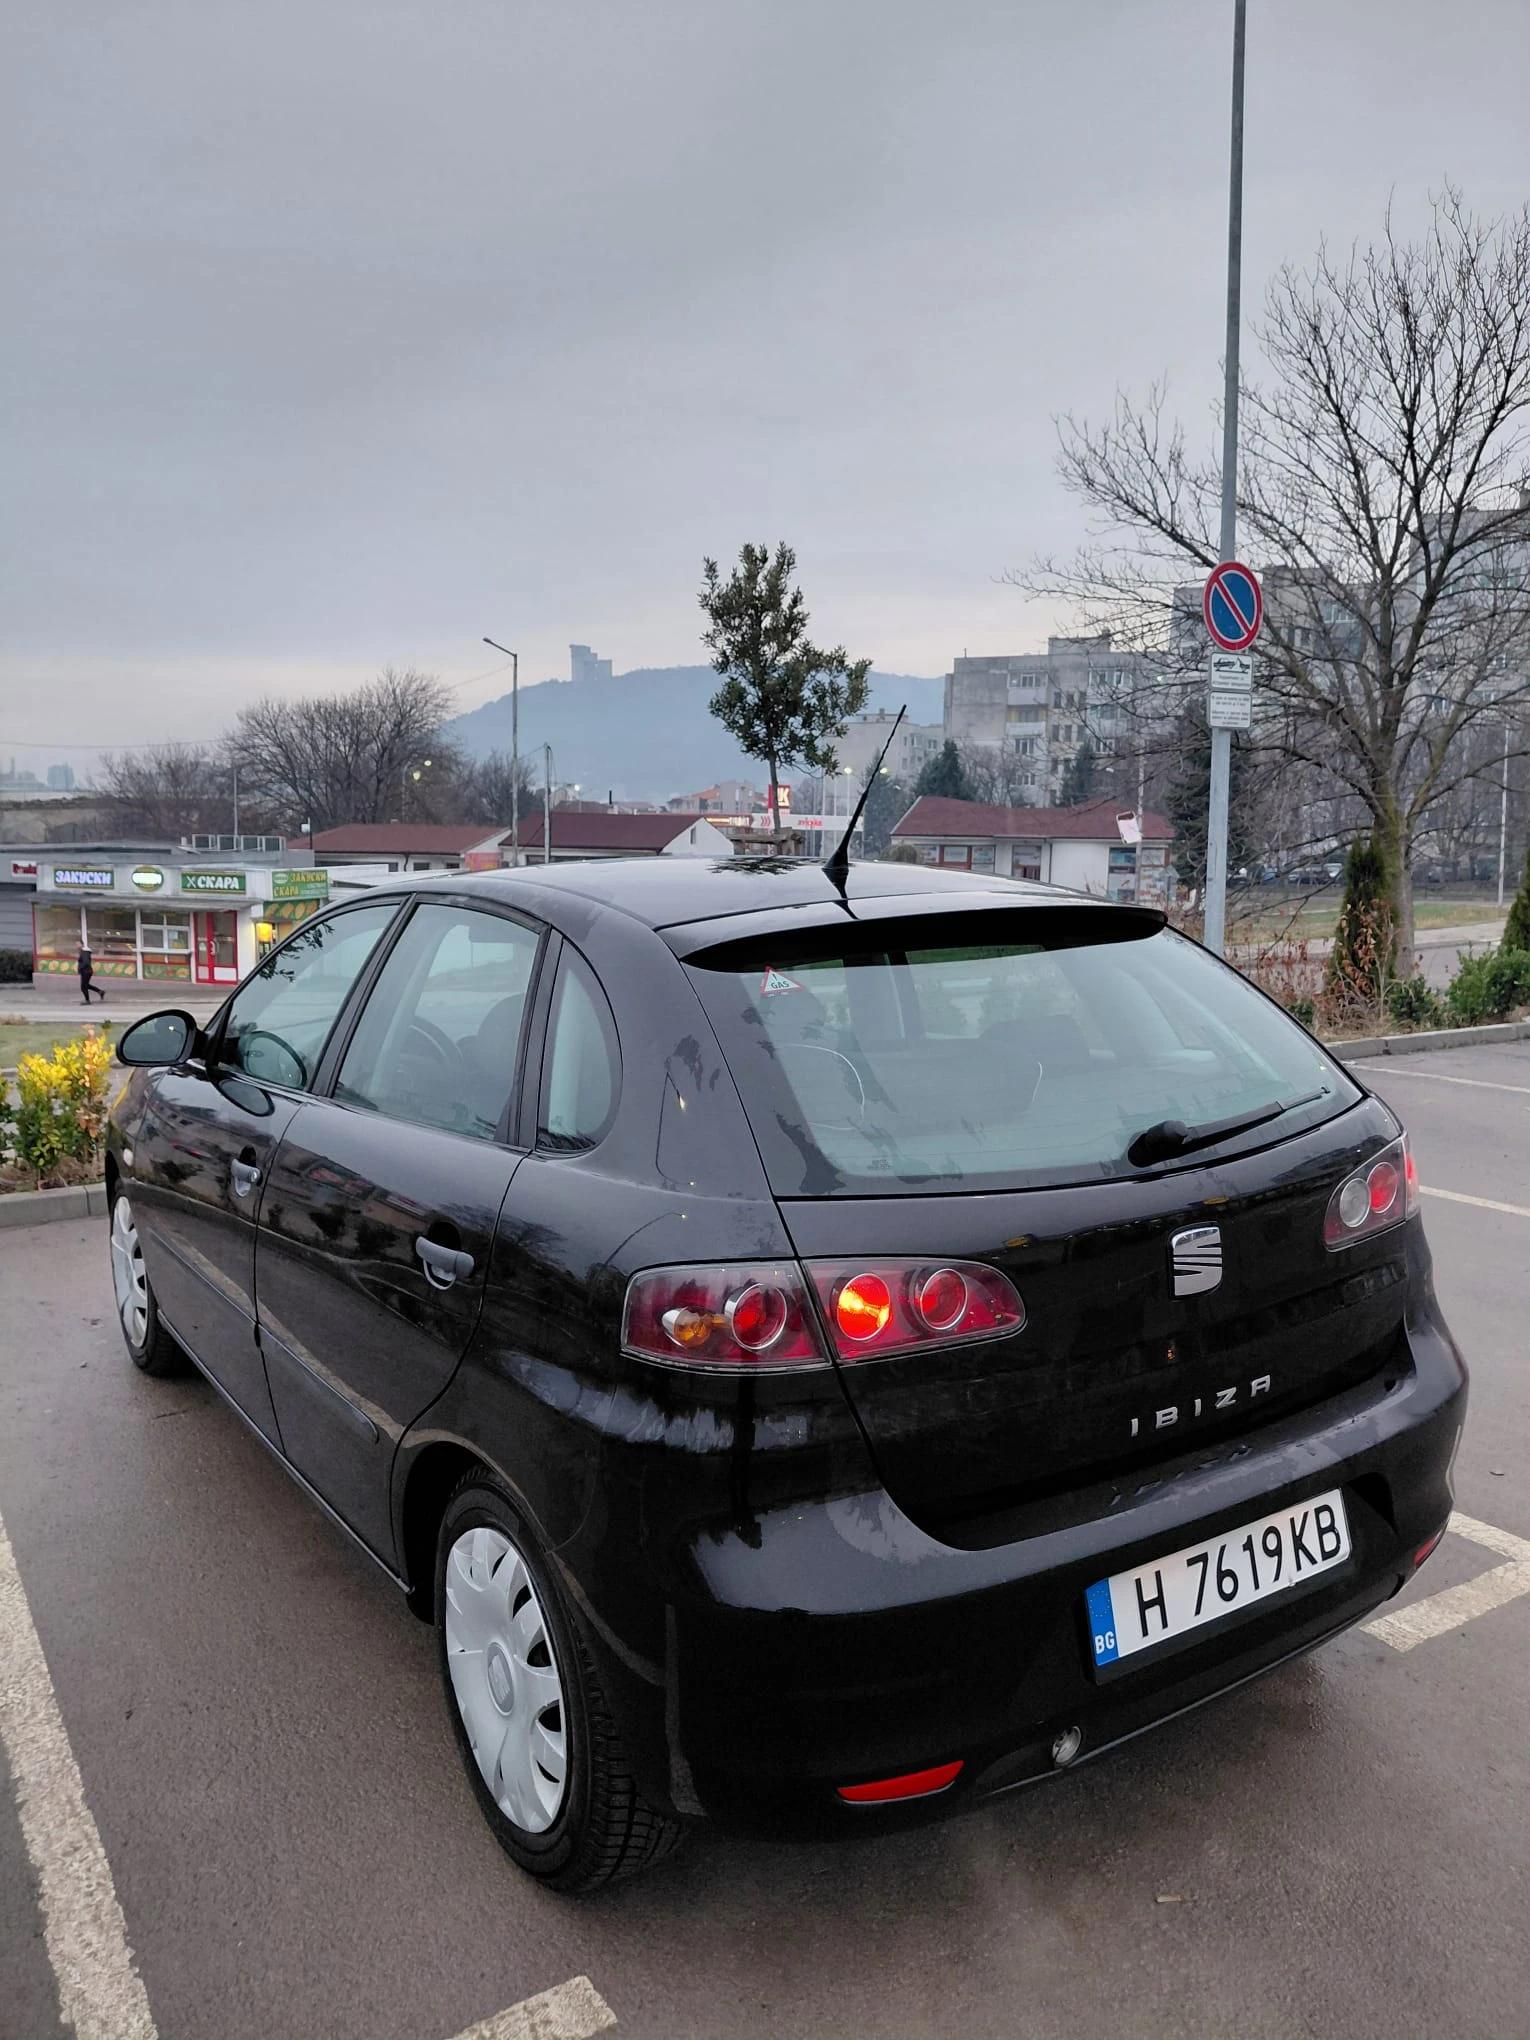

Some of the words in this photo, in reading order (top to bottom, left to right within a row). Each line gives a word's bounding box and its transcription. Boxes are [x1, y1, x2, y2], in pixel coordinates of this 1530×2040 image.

[55, 870, 112, 885] ЗАКУСКИ
[197, 875, 240, 890] СКАРА
[770, 981, 790, 989] GAS
[1131, 1374, 1271, 1437] IBIZA
[1095, 1631, 1115, 1654] BG
